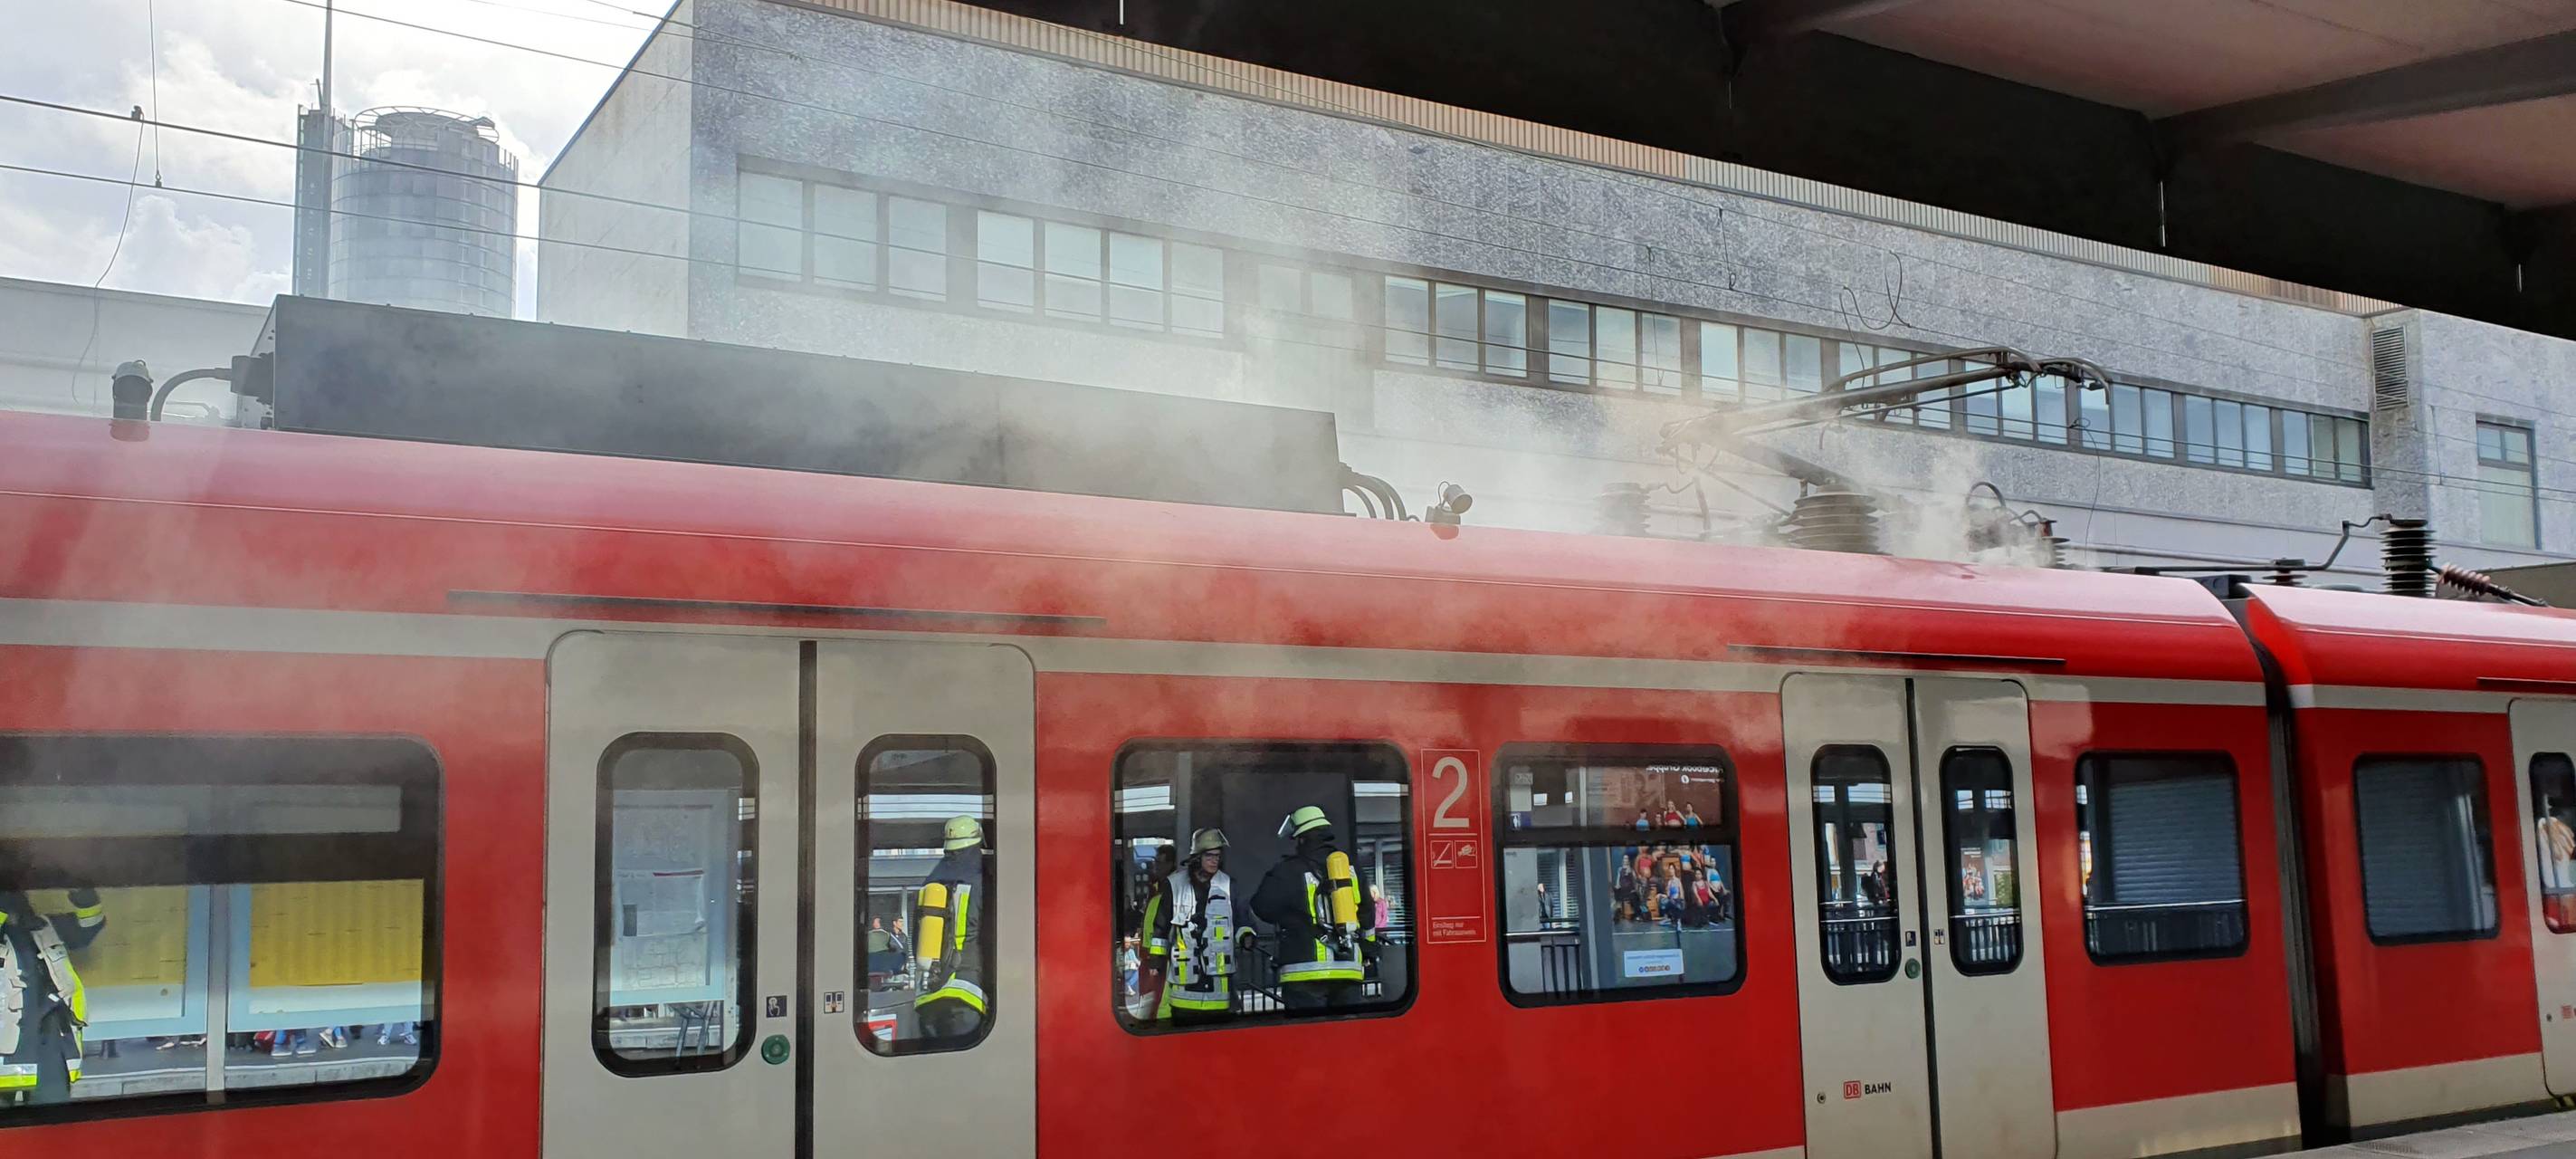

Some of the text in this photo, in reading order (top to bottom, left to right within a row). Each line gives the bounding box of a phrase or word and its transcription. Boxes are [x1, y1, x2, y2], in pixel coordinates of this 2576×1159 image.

[1432, 757, 1469, 828] 2
[1846, 1082, 1892, 1097] DB BAHN
